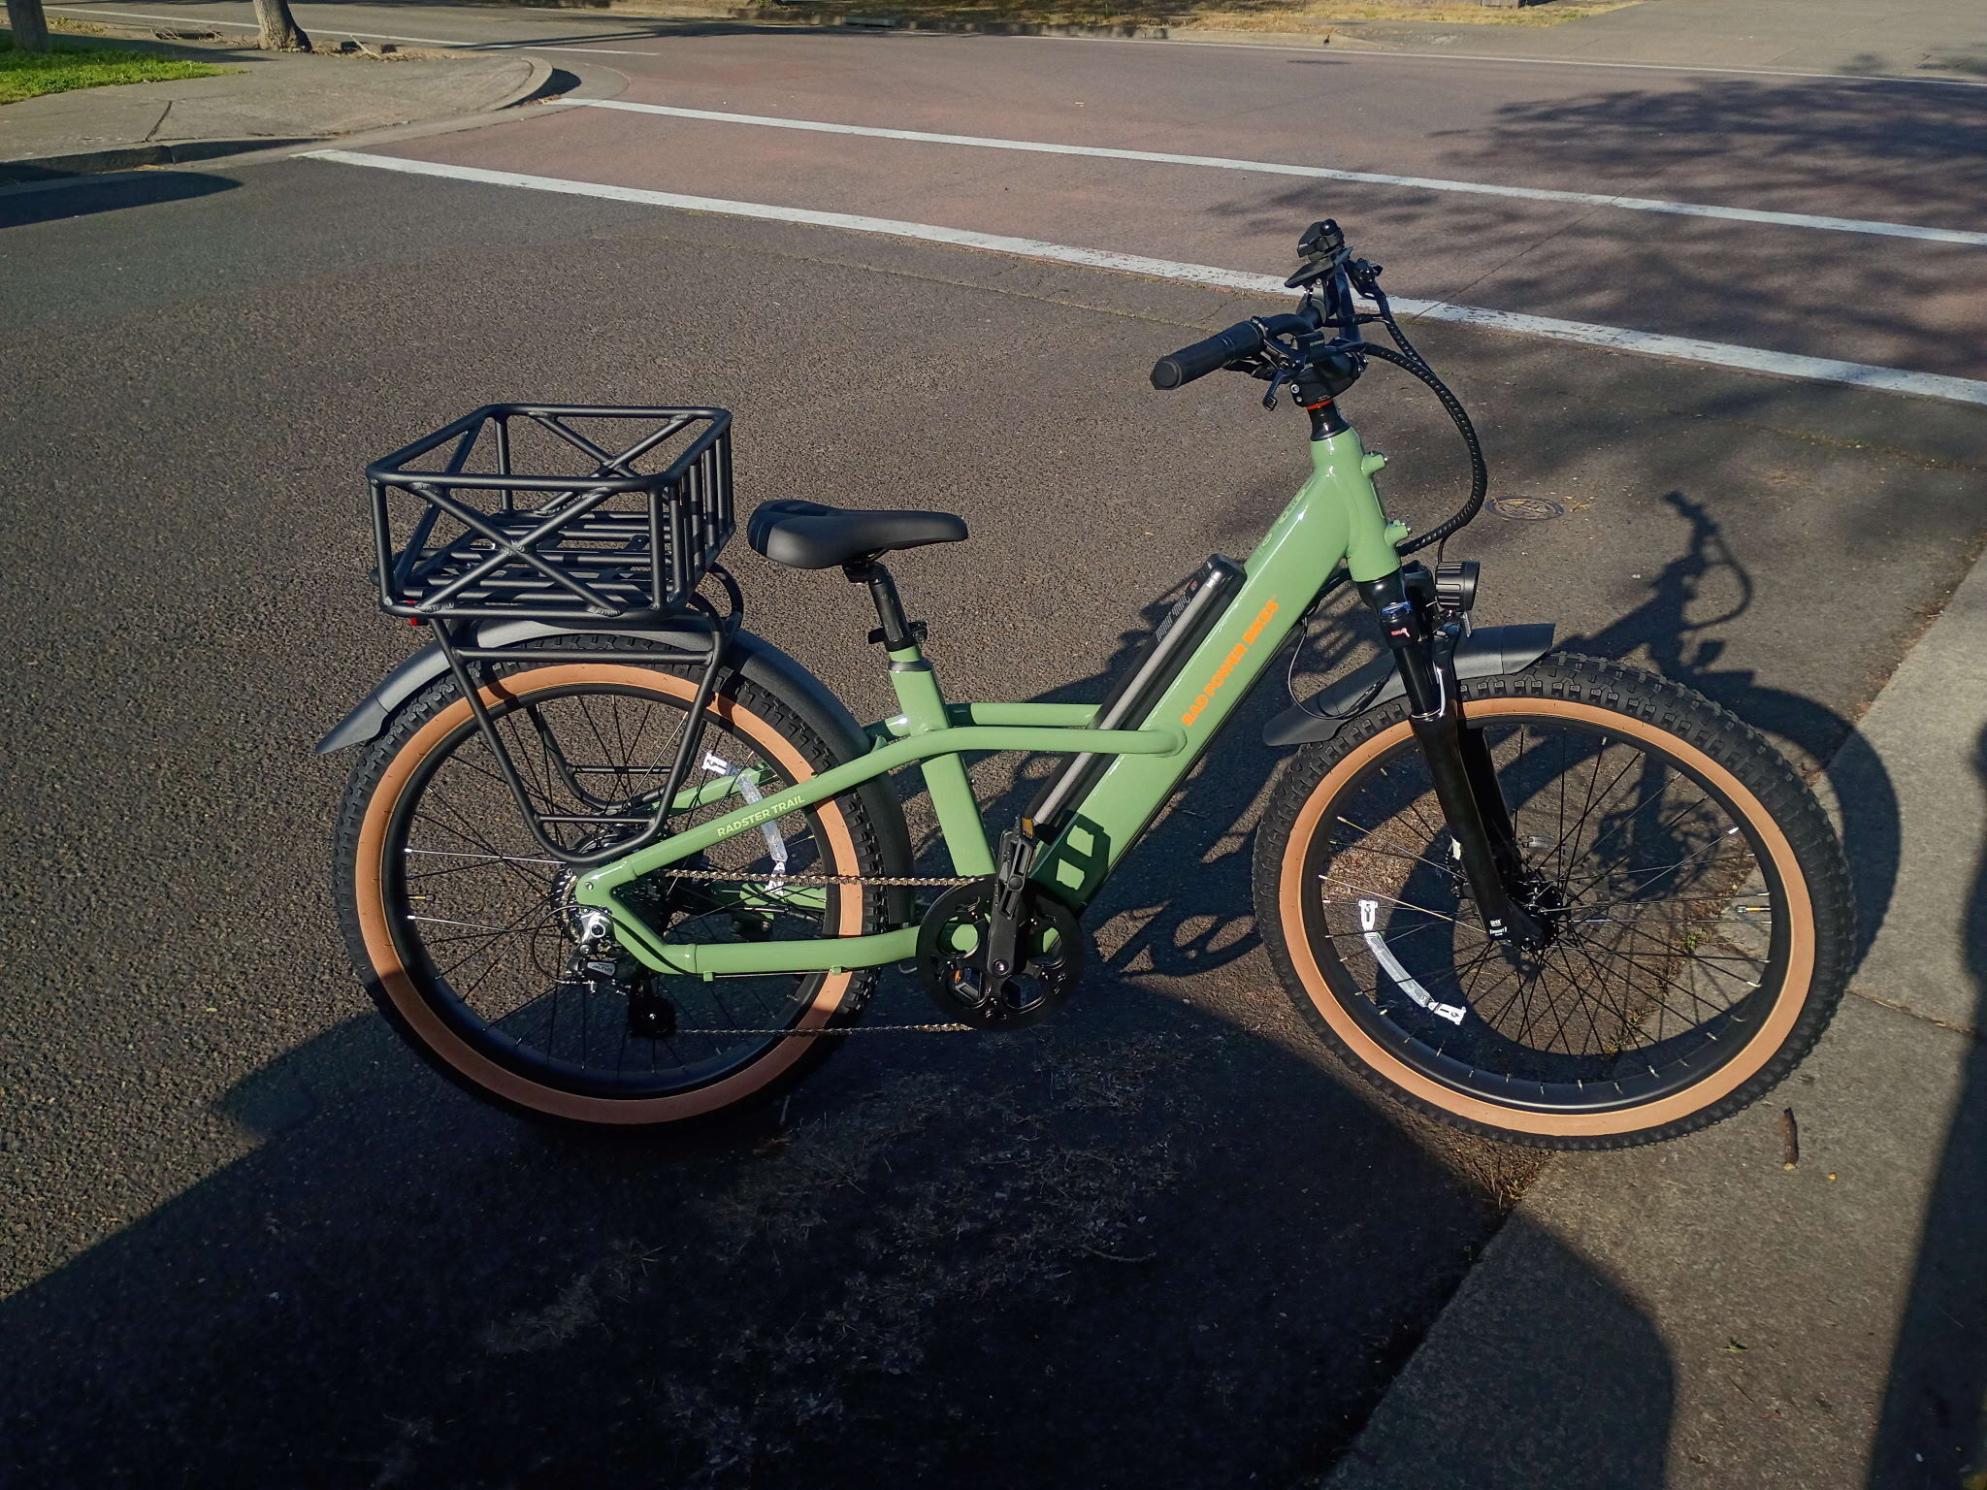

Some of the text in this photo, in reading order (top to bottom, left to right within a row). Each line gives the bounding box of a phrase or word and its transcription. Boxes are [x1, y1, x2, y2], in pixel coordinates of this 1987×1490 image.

[1182, 693, 1208, 727] RAD
[717, 795, 805, 837] RADSTER TRAIL
